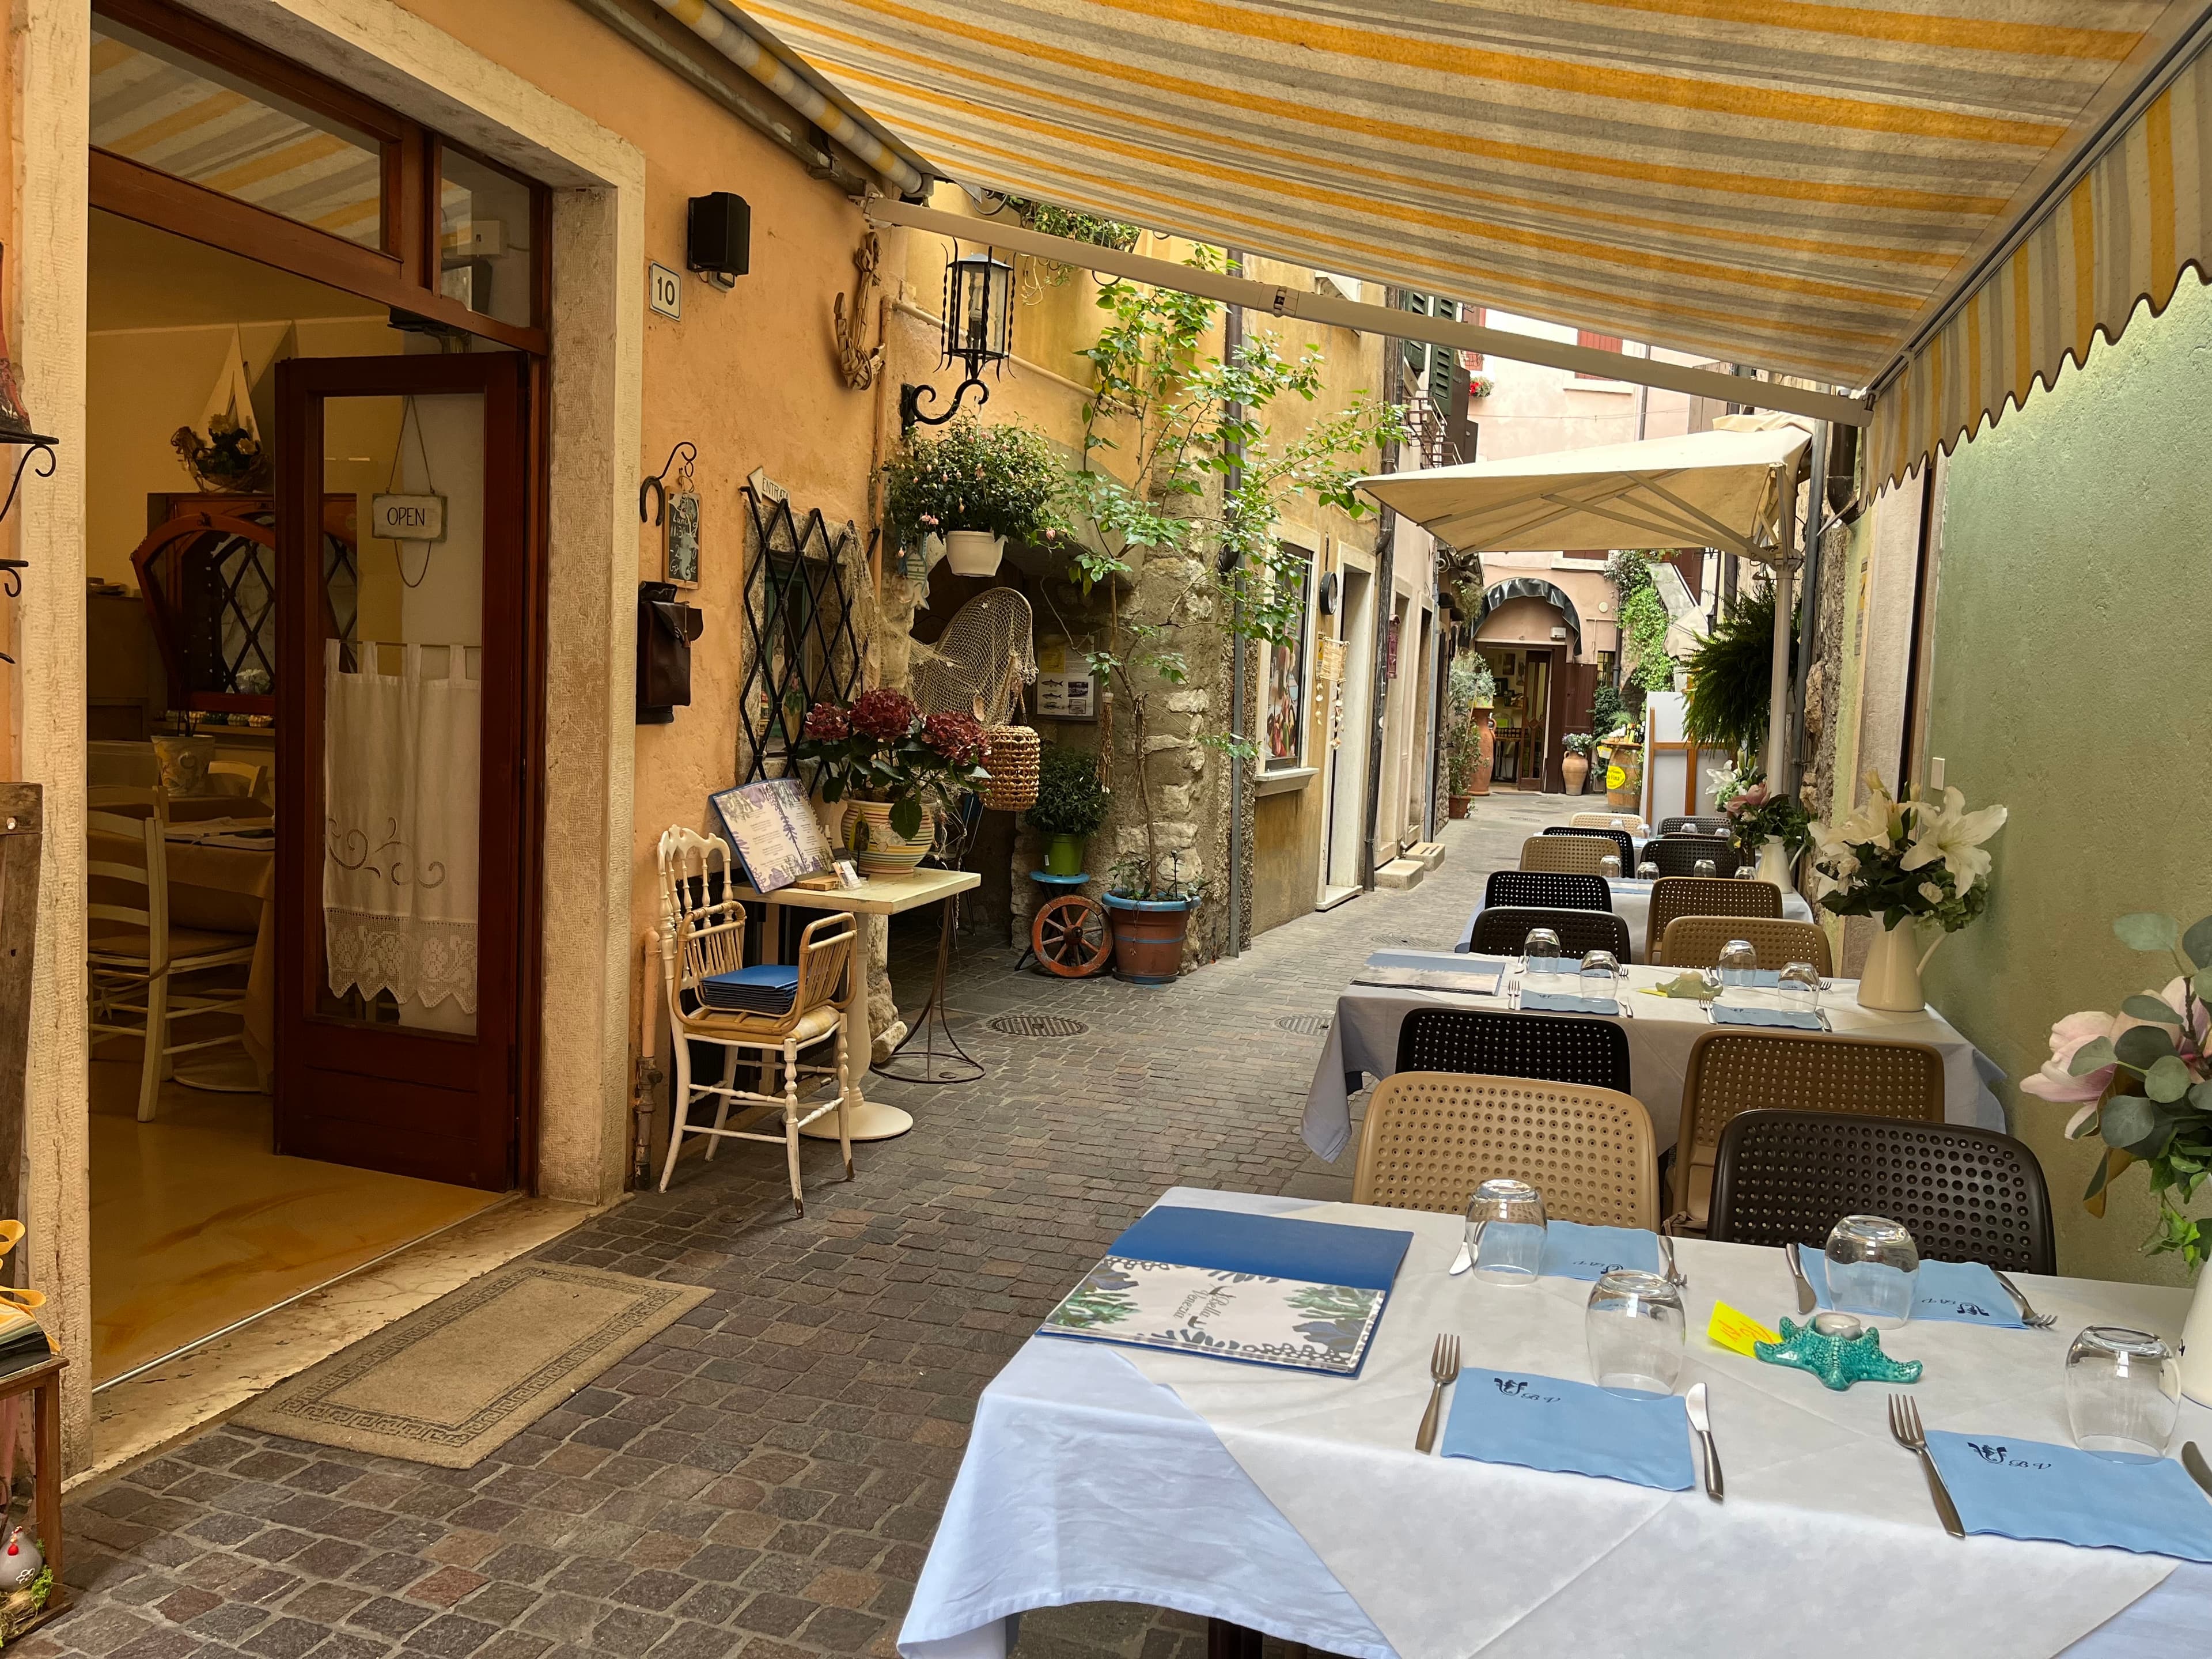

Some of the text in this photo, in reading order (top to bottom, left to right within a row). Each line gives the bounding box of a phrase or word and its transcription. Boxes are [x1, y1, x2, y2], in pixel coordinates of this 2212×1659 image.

[657, 276, 675, 306] 10
[387, 507, 425, 526] OPEN
[673, 511, 690, 525] Lunc
[1173, 1290, 1209, 1319] Venezia
